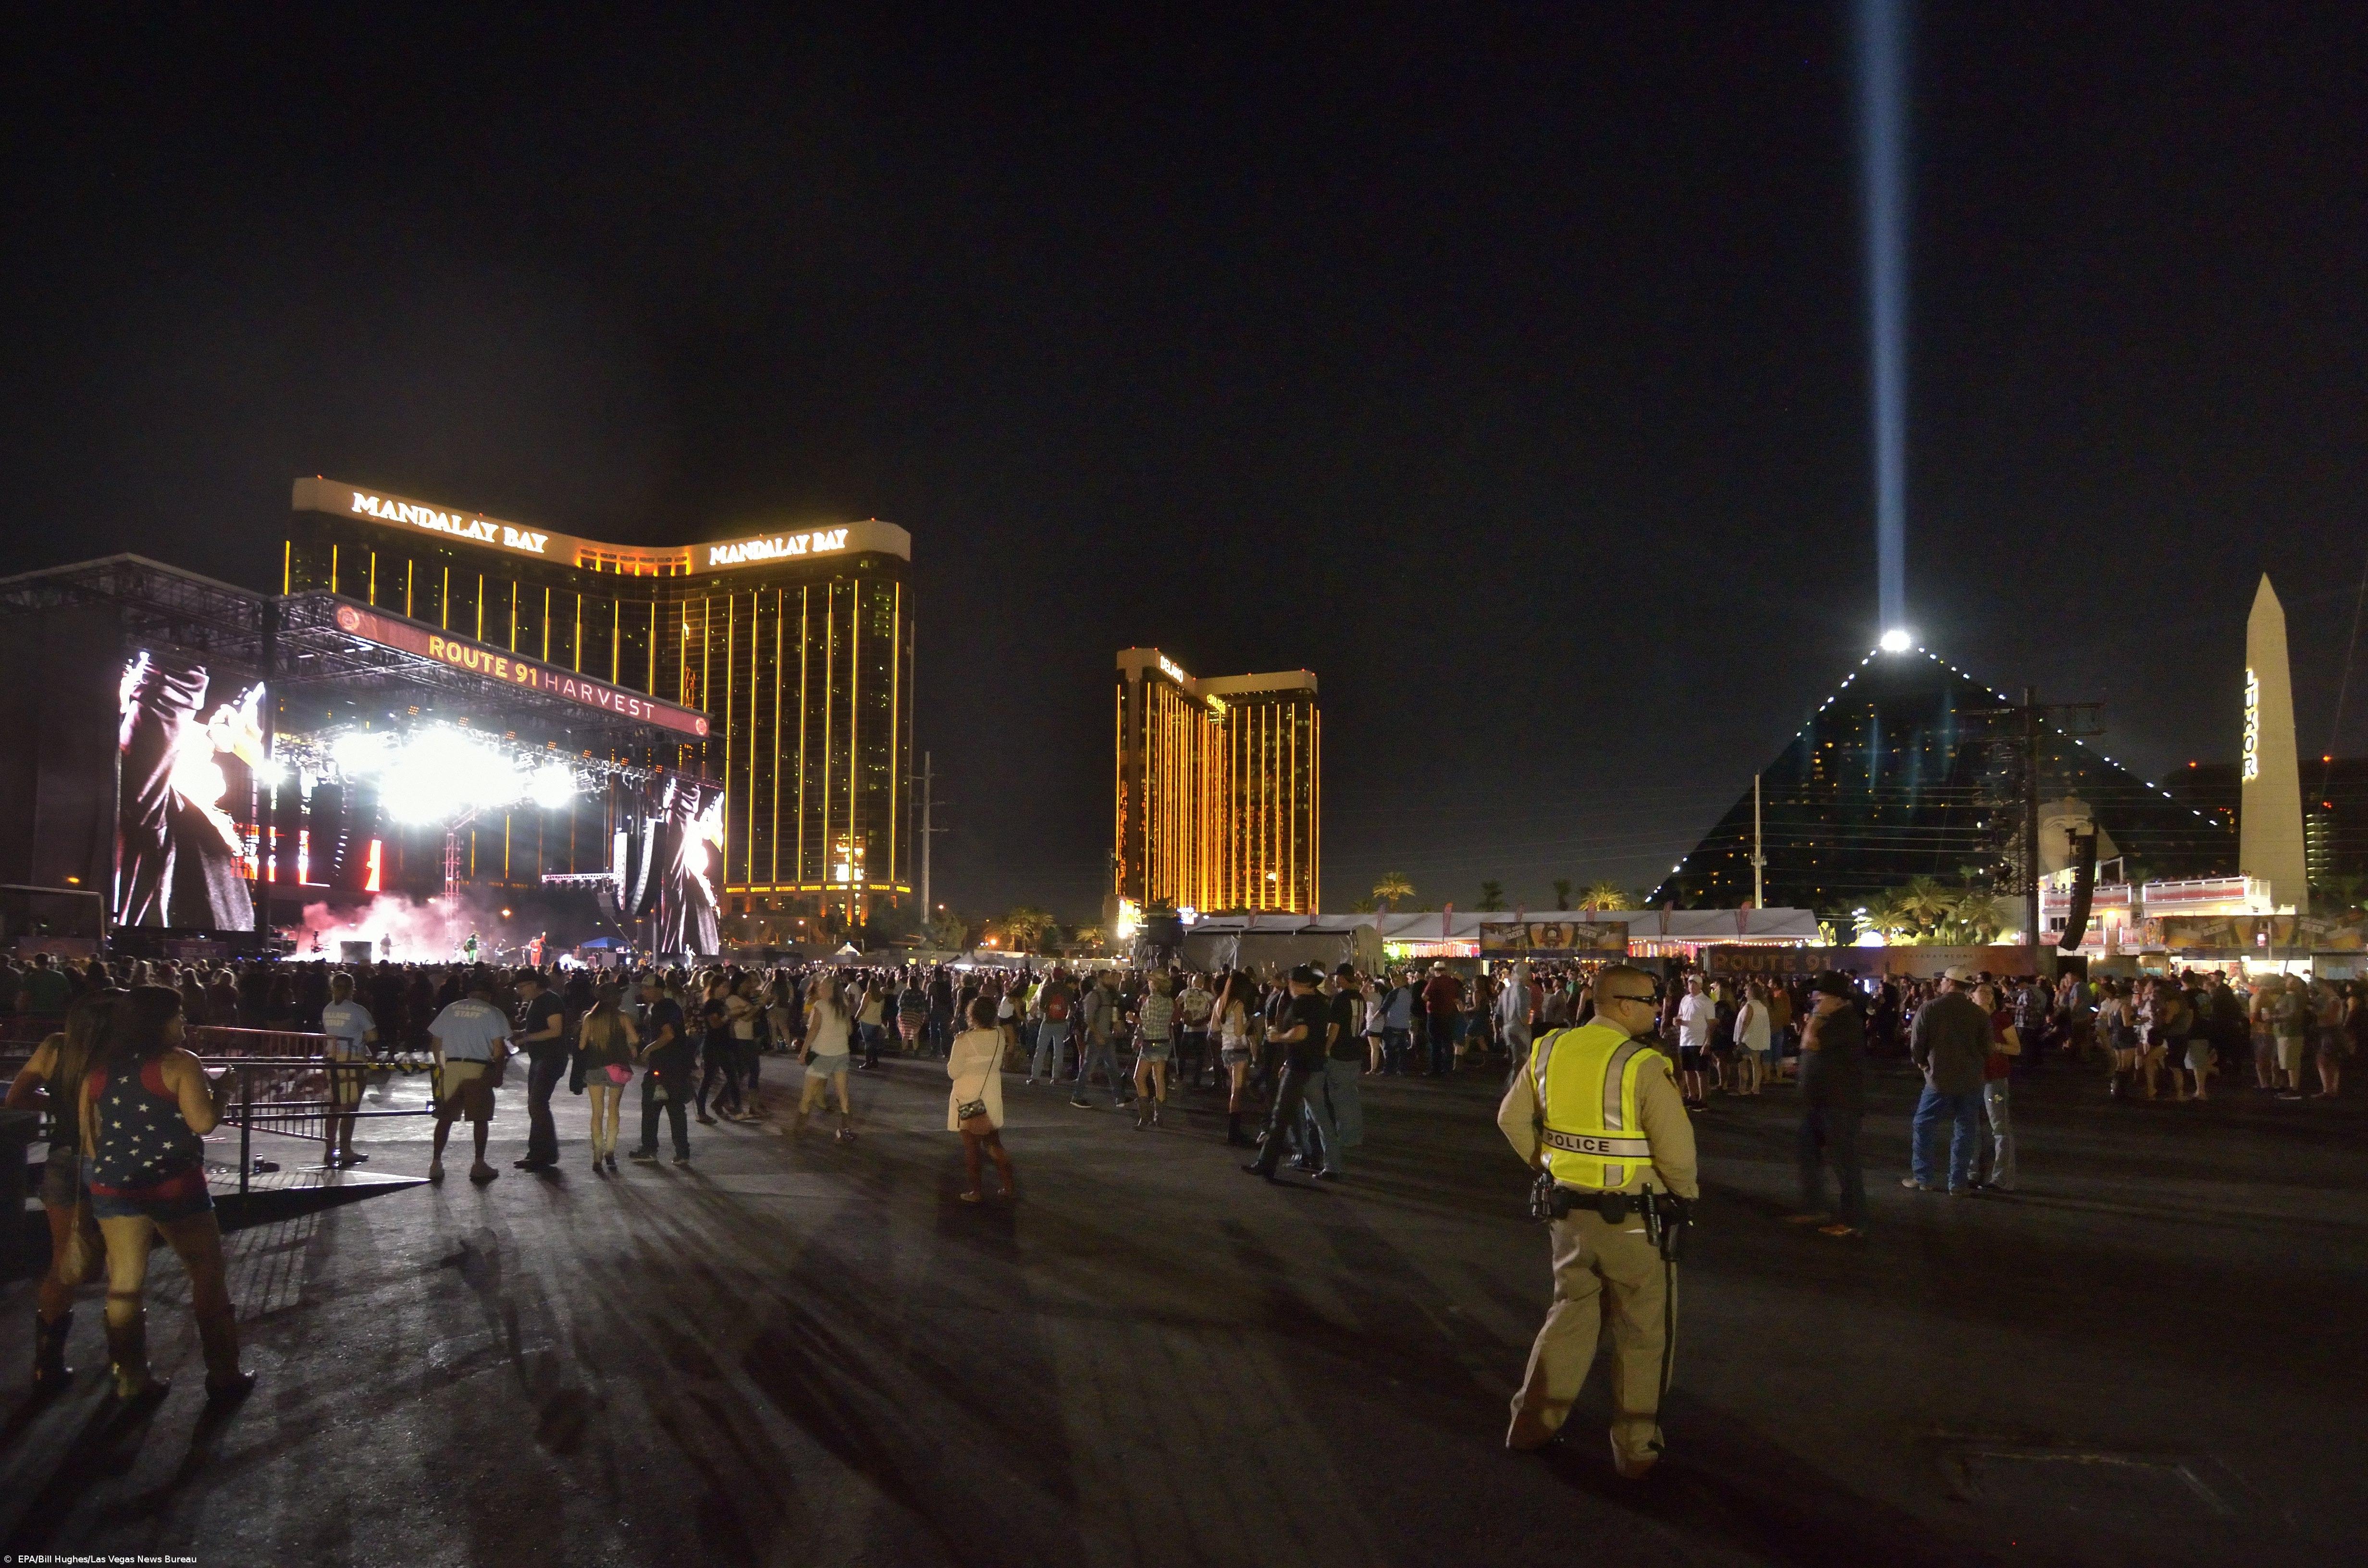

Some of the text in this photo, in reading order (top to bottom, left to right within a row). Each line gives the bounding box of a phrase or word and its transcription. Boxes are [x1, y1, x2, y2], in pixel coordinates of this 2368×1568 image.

[352, 492, 549, 553] MANDALAY BAY
[709, 529, 849, 566] MANDALAY BAY
[429, 635, 655, 720] ROUTE 91 HARVEST
[1713, 954, 1832, 971] ROUTE 91
[1547, 1132, 1610, 1152] POLICE
